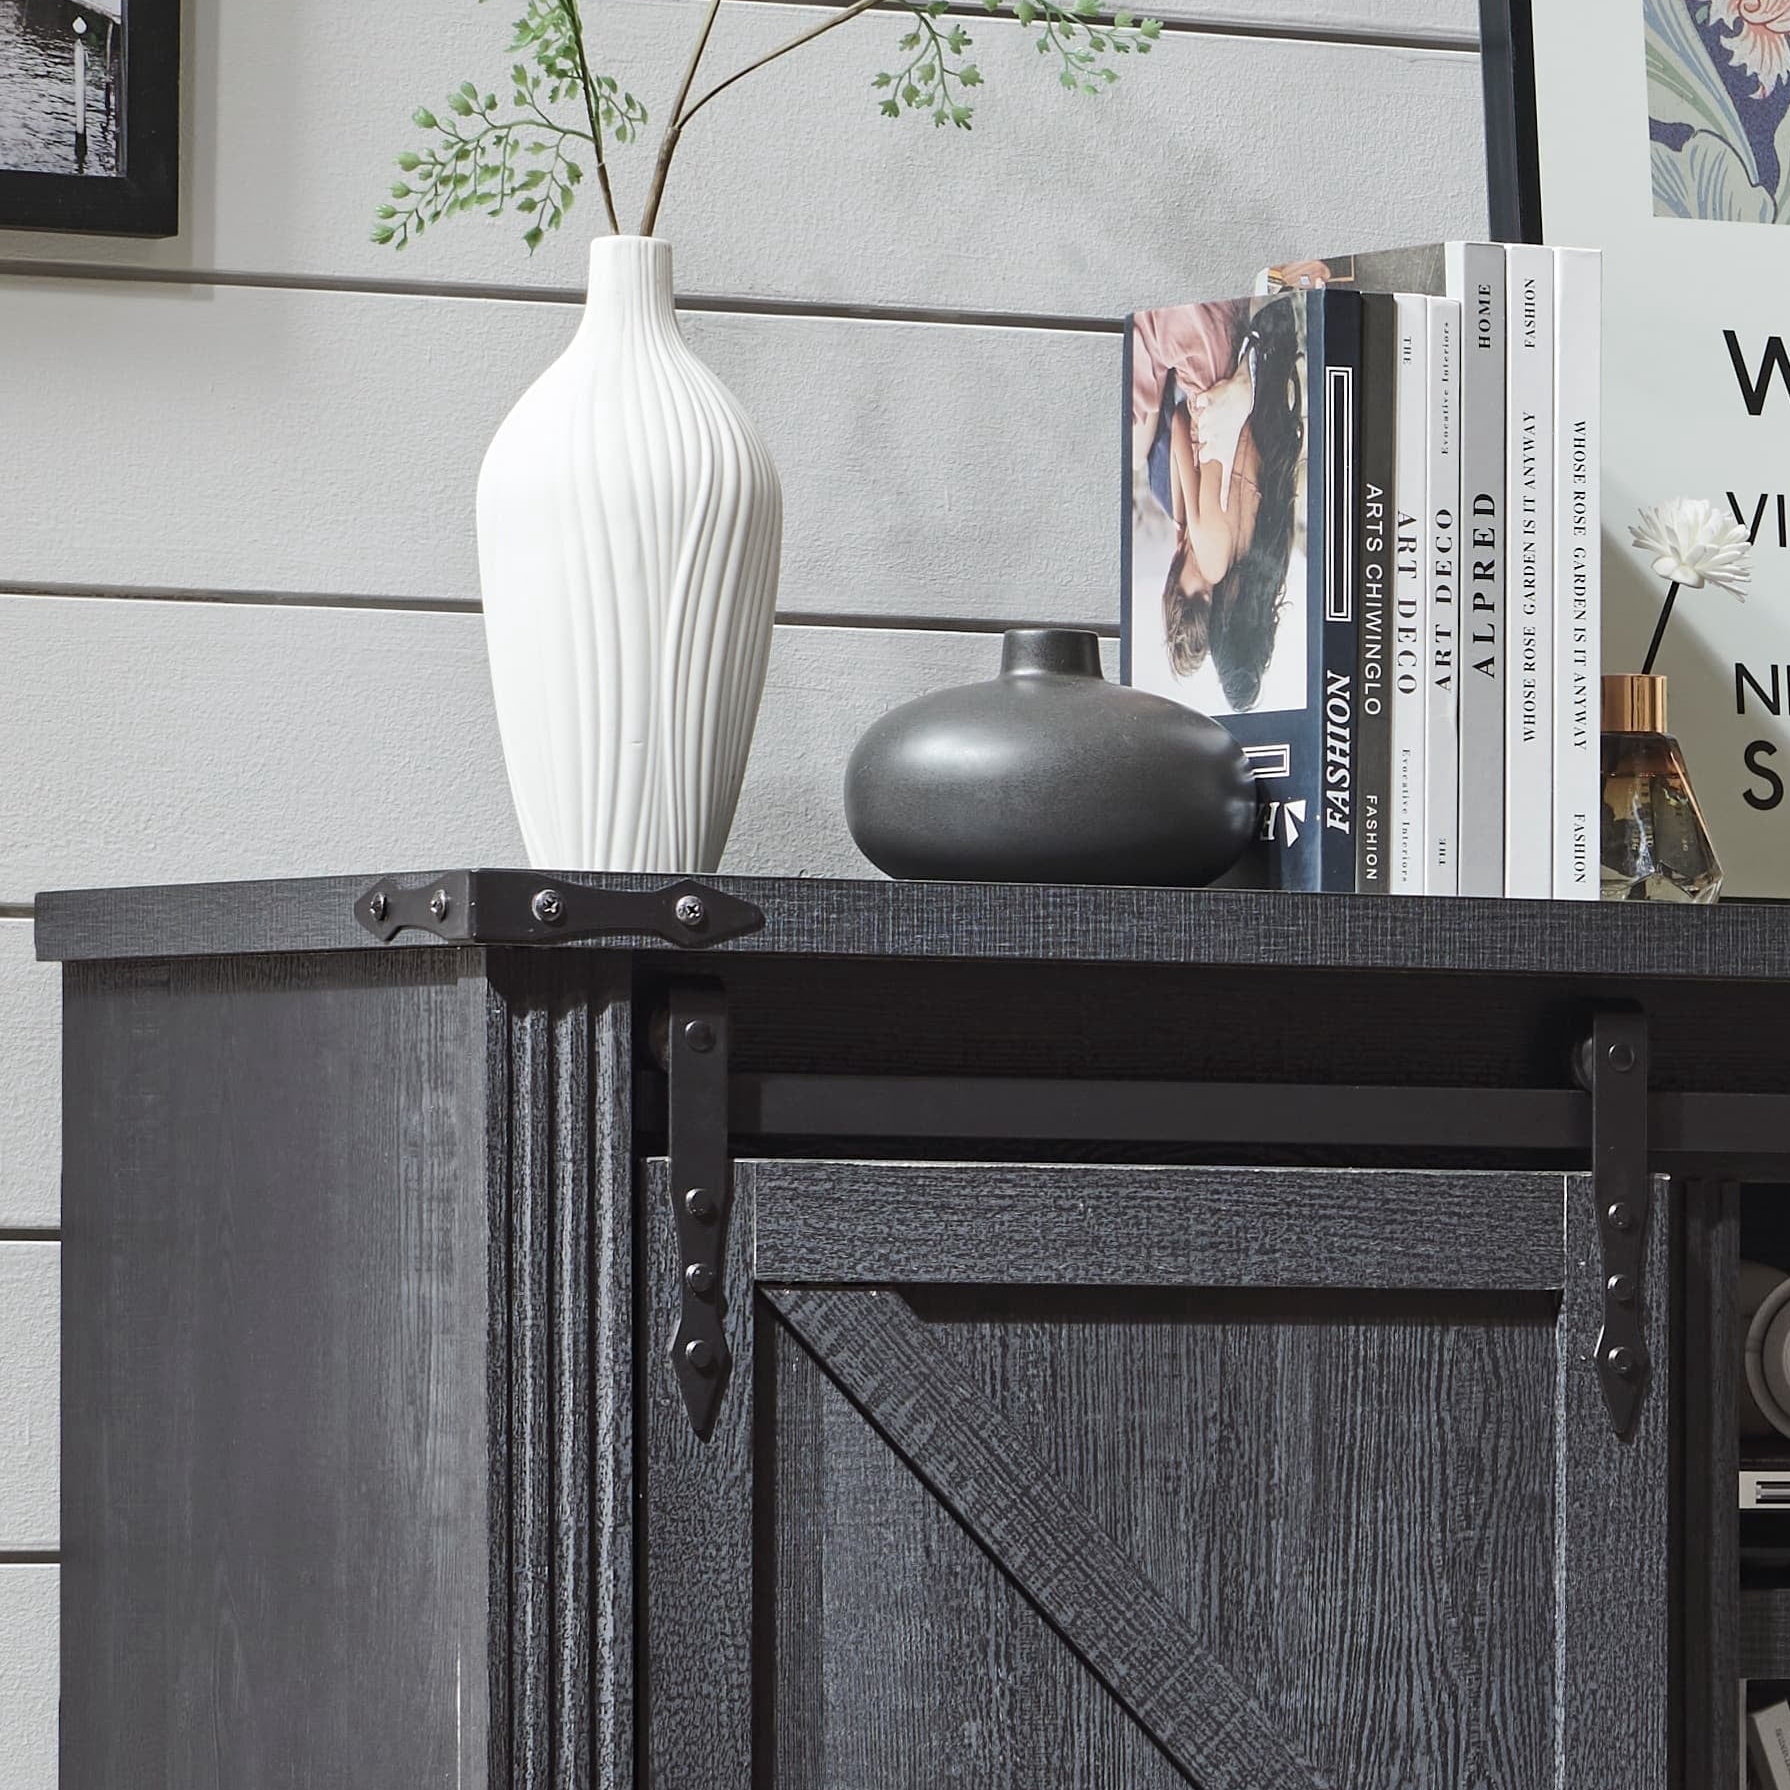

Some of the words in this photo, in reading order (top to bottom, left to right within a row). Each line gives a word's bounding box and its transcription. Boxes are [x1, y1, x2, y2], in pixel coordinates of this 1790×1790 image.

[1478, 284, 1491, 349] HOME
[1524, 278, 1536, 348] FASHION
[1403, 336, 1412, 365] THE
[1442, 321, 1450, 382] Interiors
[1441, 388, 1449, 455] Evocative
[1523, 411, 1536, 490] ANYWAY
[1573, 420, 1586, 483] WHOSE
[1366, 483, 1384, 552] ARTS
[1523, 495, 1536, 513] IT
[1523, 519, 1536, 535] IS
[1573, 490, 1586, 536] ROSE
[1398, 511, 1417, 578] ART
[1435, 509, 1453, 605] DECO
[1523, 542, 1536, 615] GARDEN
[1472, 493, 1496, 678] ALPRED
[1574, 547, 1586, 620] GARDEN
[1364, 564, 1383, 715] CHIWINGLO
[1397, 599, 1417, 694] DECO
[1435, 624, 1452, 692] ART
[1523, 626, 1536, 672] ROSE
[1574, 628, 1587, 642] IS
[1574, 649, 1587, 664] IT
[1523, 678, 1536, 742] WHOSE
[1574, 672, 1587, 750] ANYWAY
[1326, 670, 1350, 834] FASHION
[1366, 795, 1378, 880] FASHION
[1574, 813, 1585, 883] FASHION
